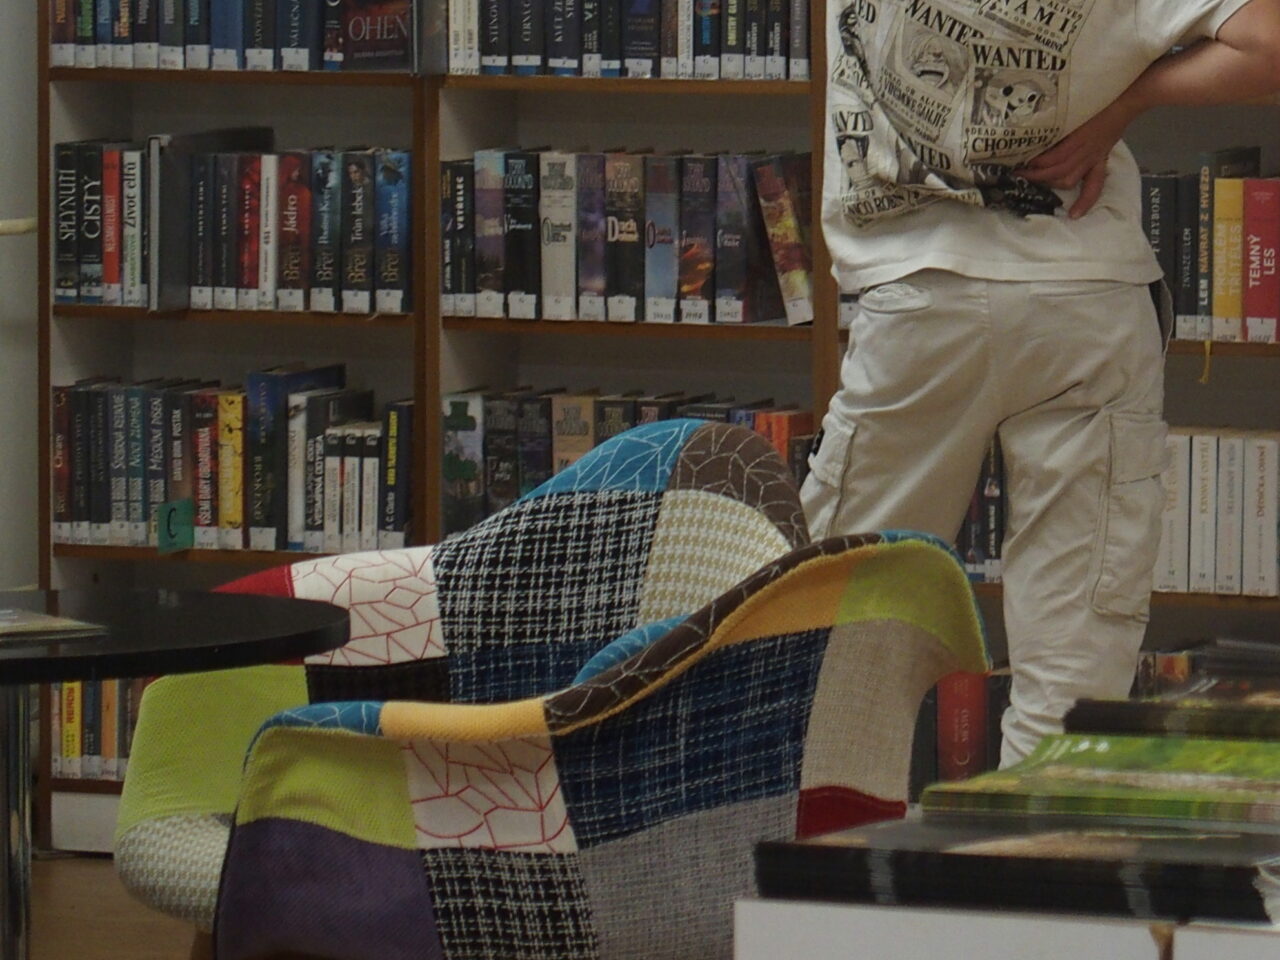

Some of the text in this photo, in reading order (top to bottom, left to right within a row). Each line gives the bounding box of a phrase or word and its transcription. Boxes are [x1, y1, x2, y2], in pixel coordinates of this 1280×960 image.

[973, 45, 1066, 72] WANTED
[971, 127, 997, 136] DEAD
[1003, 127, 1018, 136] OR
[57, 168, 77, 241] SPLYNUTÍ
[81, 175, 102, 240] ČISTÝ
[123, 160, 137, 229] Život elfů
[282, 193, 299, 234] Jádro
[350, 186, 364, 241] Trůn lebek
[456, 176, 464, 231] VETŘELEC
[1150, 187, 1161, 253] FURYBORN
[1198, 166, 1210, 306] LEM NÁVRAT Z HVĚZD
[1215, 223, 1227, 296] PROBLÉM
[1247, 234, 1261, 289] TEMNÝ
[1263, 247, 1276, 276] LES
[198, 479, 211, 501] DARY
[198, 500, 212, 525] VŠEMI
